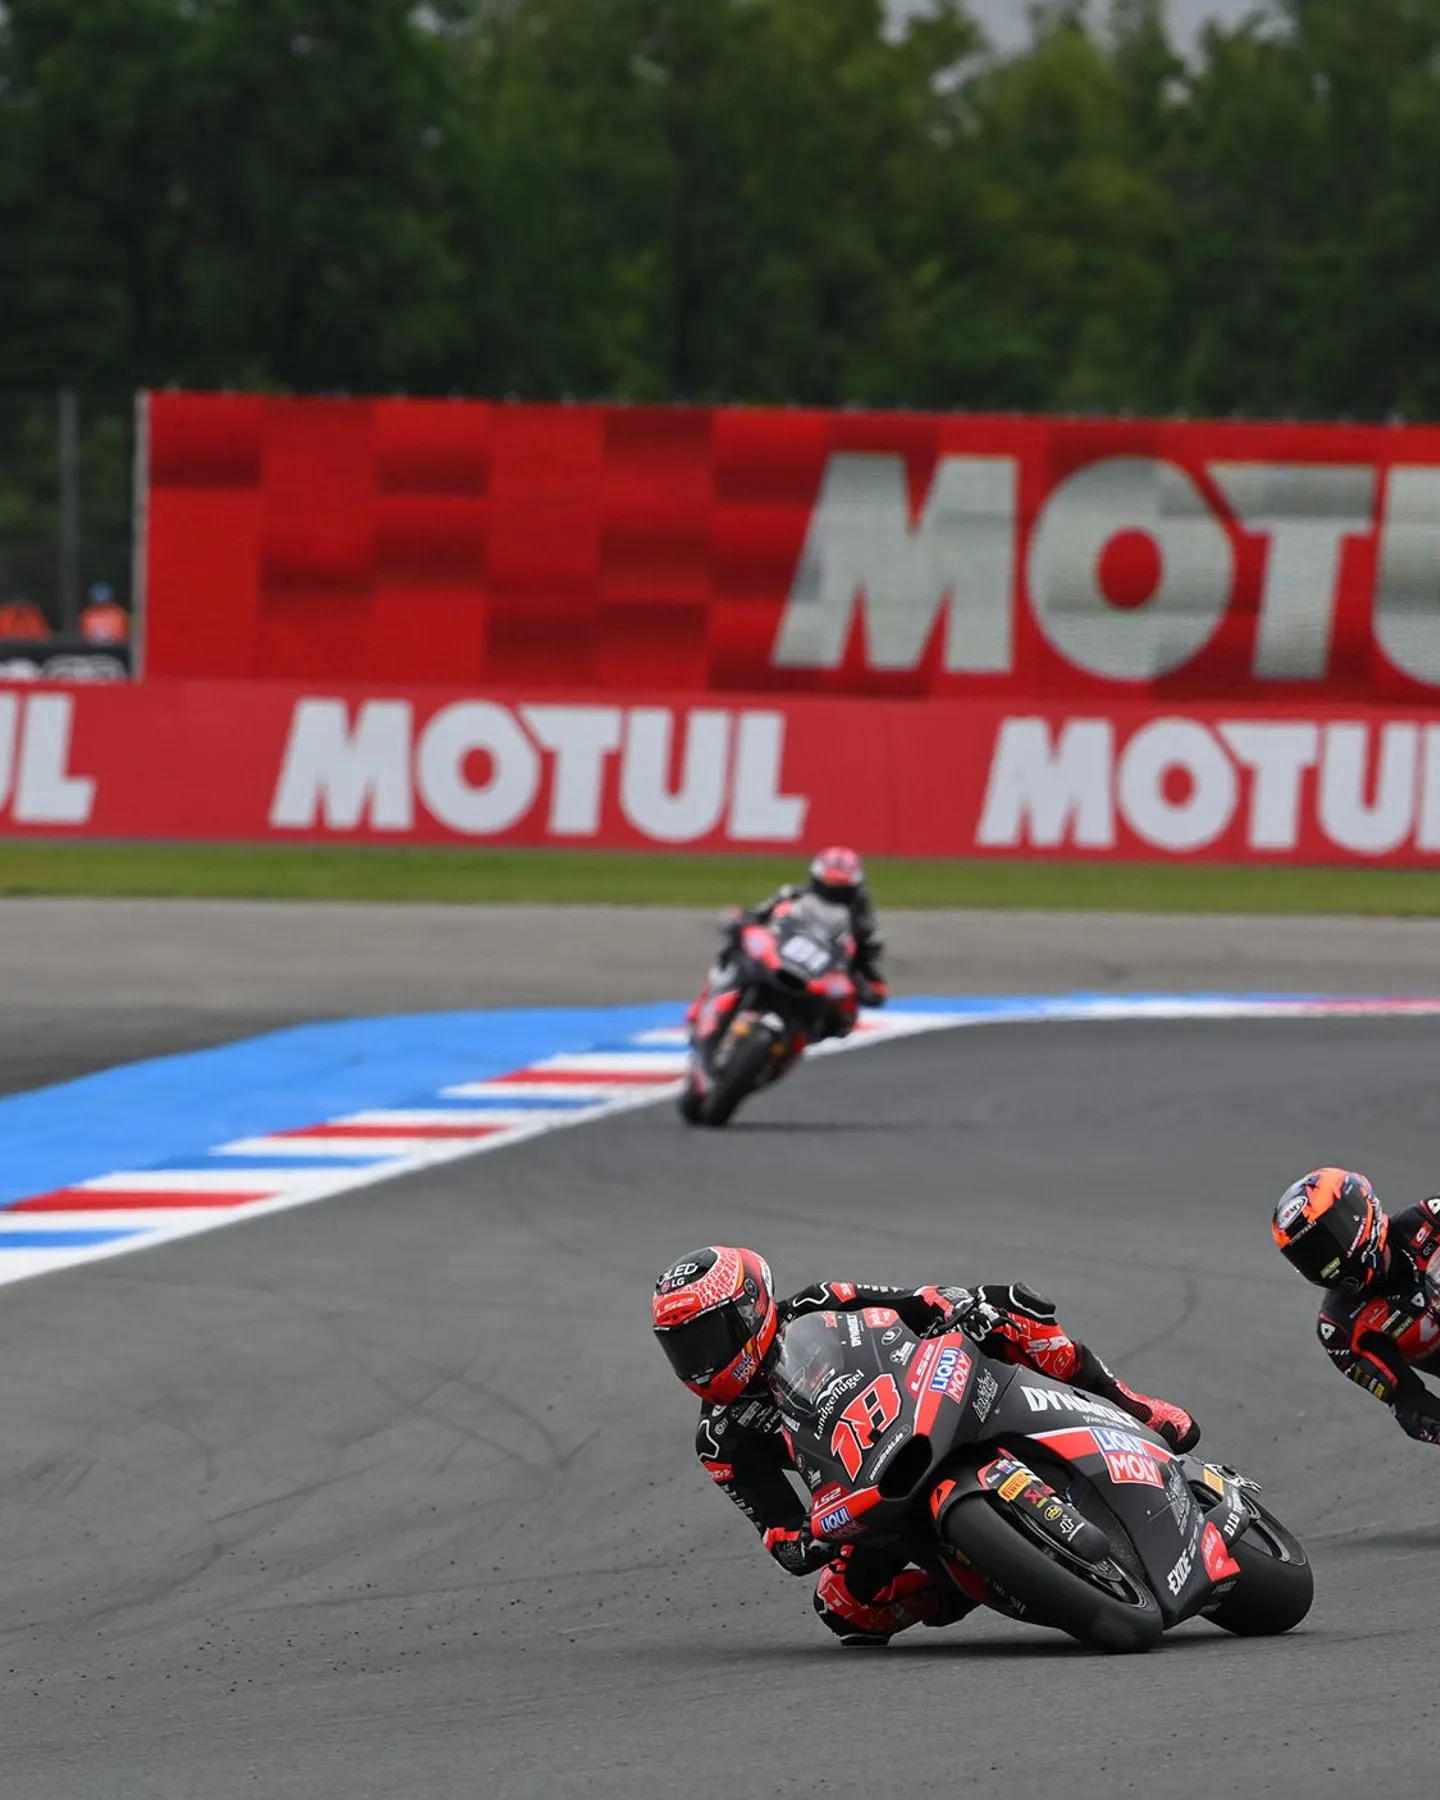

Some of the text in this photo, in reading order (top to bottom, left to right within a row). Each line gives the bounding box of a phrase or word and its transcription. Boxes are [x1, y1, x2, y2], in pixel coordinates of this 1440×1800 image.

[270, 698, 808, 842] MOTUL
[672, 1276, 685, 1288] LG
[931, 1348, 958, 1390] LIQUI
[946, 1353, 971, 1402] MOLY
[813, 1369, 865, 1441] Landgeflügel
[831, 1373, 902, 1482] 18
[1094, 1428, 1149, 1456] LIQUI
[1111, 1454, 1160, 1484] MOLY
[815, 1487, 841, 1510] LS2
[820, 1506, 851, 1534] LIQUI
